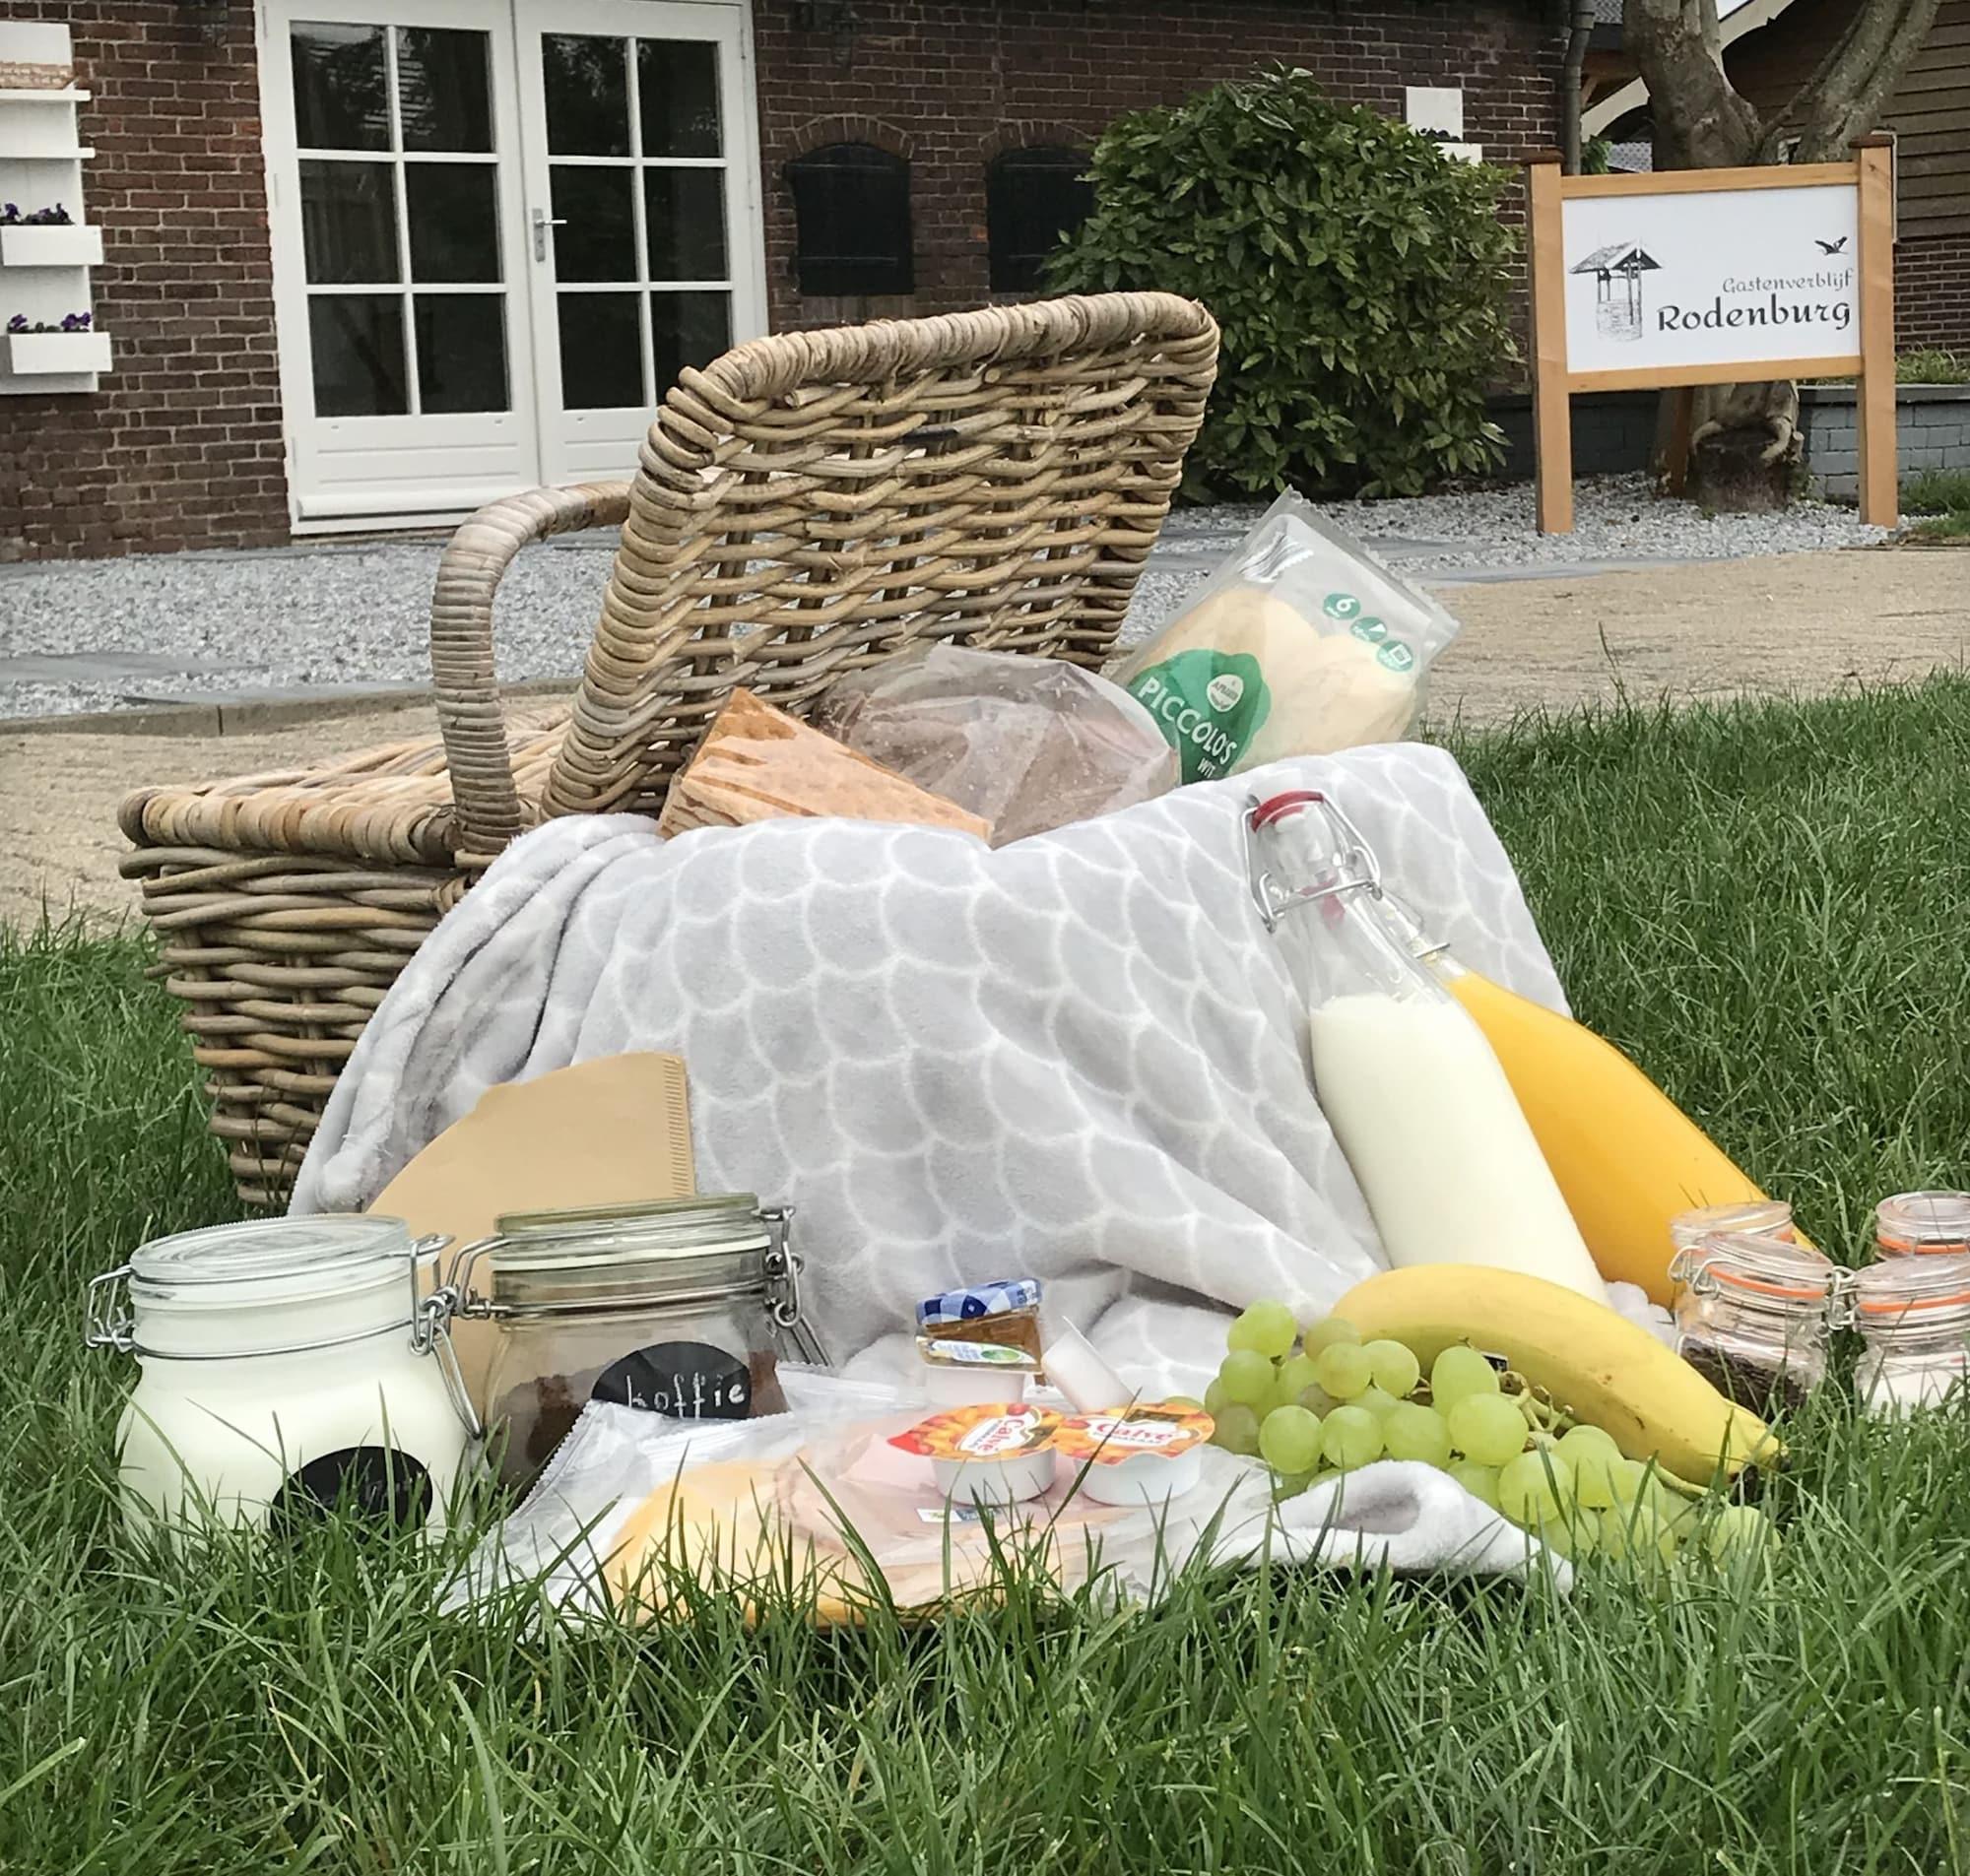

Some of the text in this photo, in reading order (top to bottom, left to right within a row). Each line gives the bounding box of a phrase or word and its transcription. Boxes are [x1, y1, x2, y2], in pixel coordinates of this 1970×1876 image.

[1722, 269, 1854, 293] Gastenverblijf
[1658, 293, 1851, 330] Rodenburg
[1336, 598, 1355, 614] 6
[625, 1371, 746, 1419] koffie
